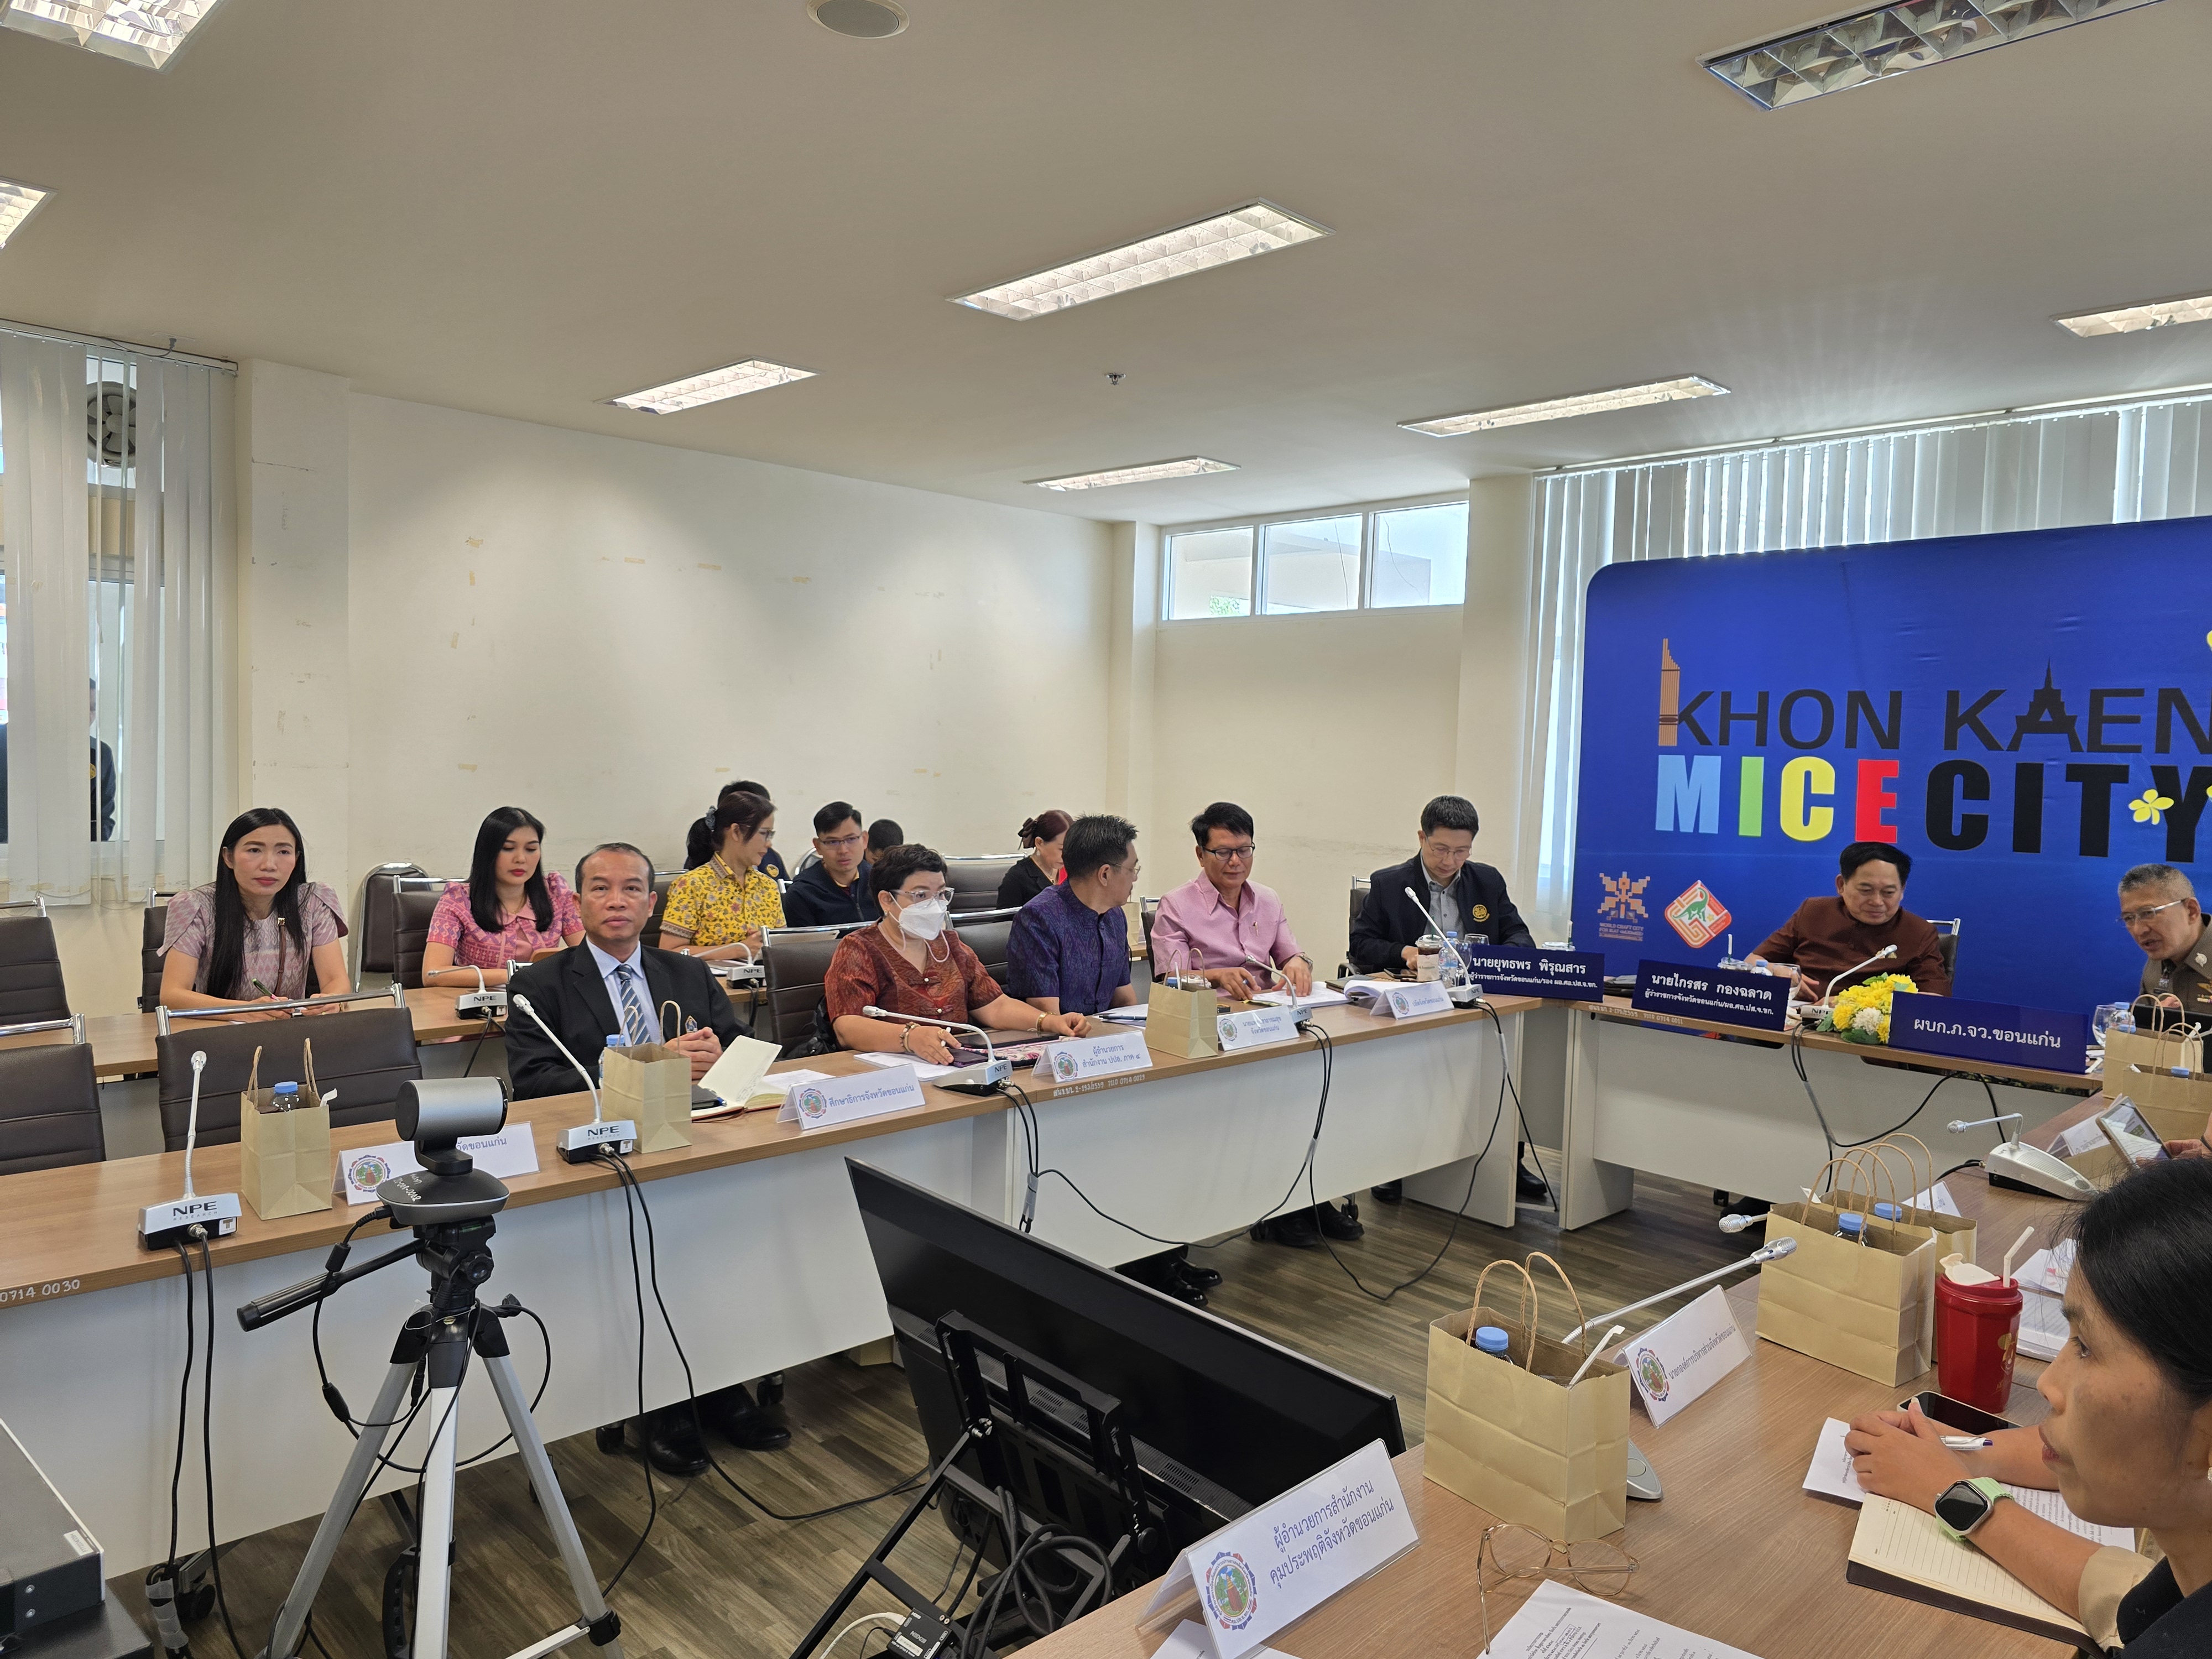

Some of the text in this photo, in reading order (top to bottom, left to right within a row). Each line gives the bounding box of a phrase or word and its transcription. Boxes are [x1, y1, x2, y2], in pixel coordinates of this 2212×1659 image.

[1659, 638, 2212, 755] KHON KAEN
[1656, 754, 2212, 863] MICE CITY
[1472, 957, 1586, 976] นายยุทธพร พิรุณสาร
[1651, 973, 1772, 1001] นายไกรสร กองฉลาด
[1913, 1018, 2061, 1048] ผบก.ภ.จว.ขอนแก่น
[1082, 1057, 1107, 1068] สำนักงาน
[1124, 1053, 1134, 1062] ภาค
[1093, 1044, 1125, 1057] ผู้อำนวยการ
[994, 1063, 1008, 1073] NPE
[828, 1082, 915, 1107] ศึกษาธิการจังหวัดขอนแก่น
[588, 1125, 620, 1137] NPE
[173, 1201, 217, 1217] NPE
[0, 1279, 81, 1302] 0714 0030
[1274, 1479, 1374, 1553] ผู้อำนวยการสำนักงาน
[1270, 1496, 1395, 1589] คุมประพฤติจังหวัดขอนแก่น
